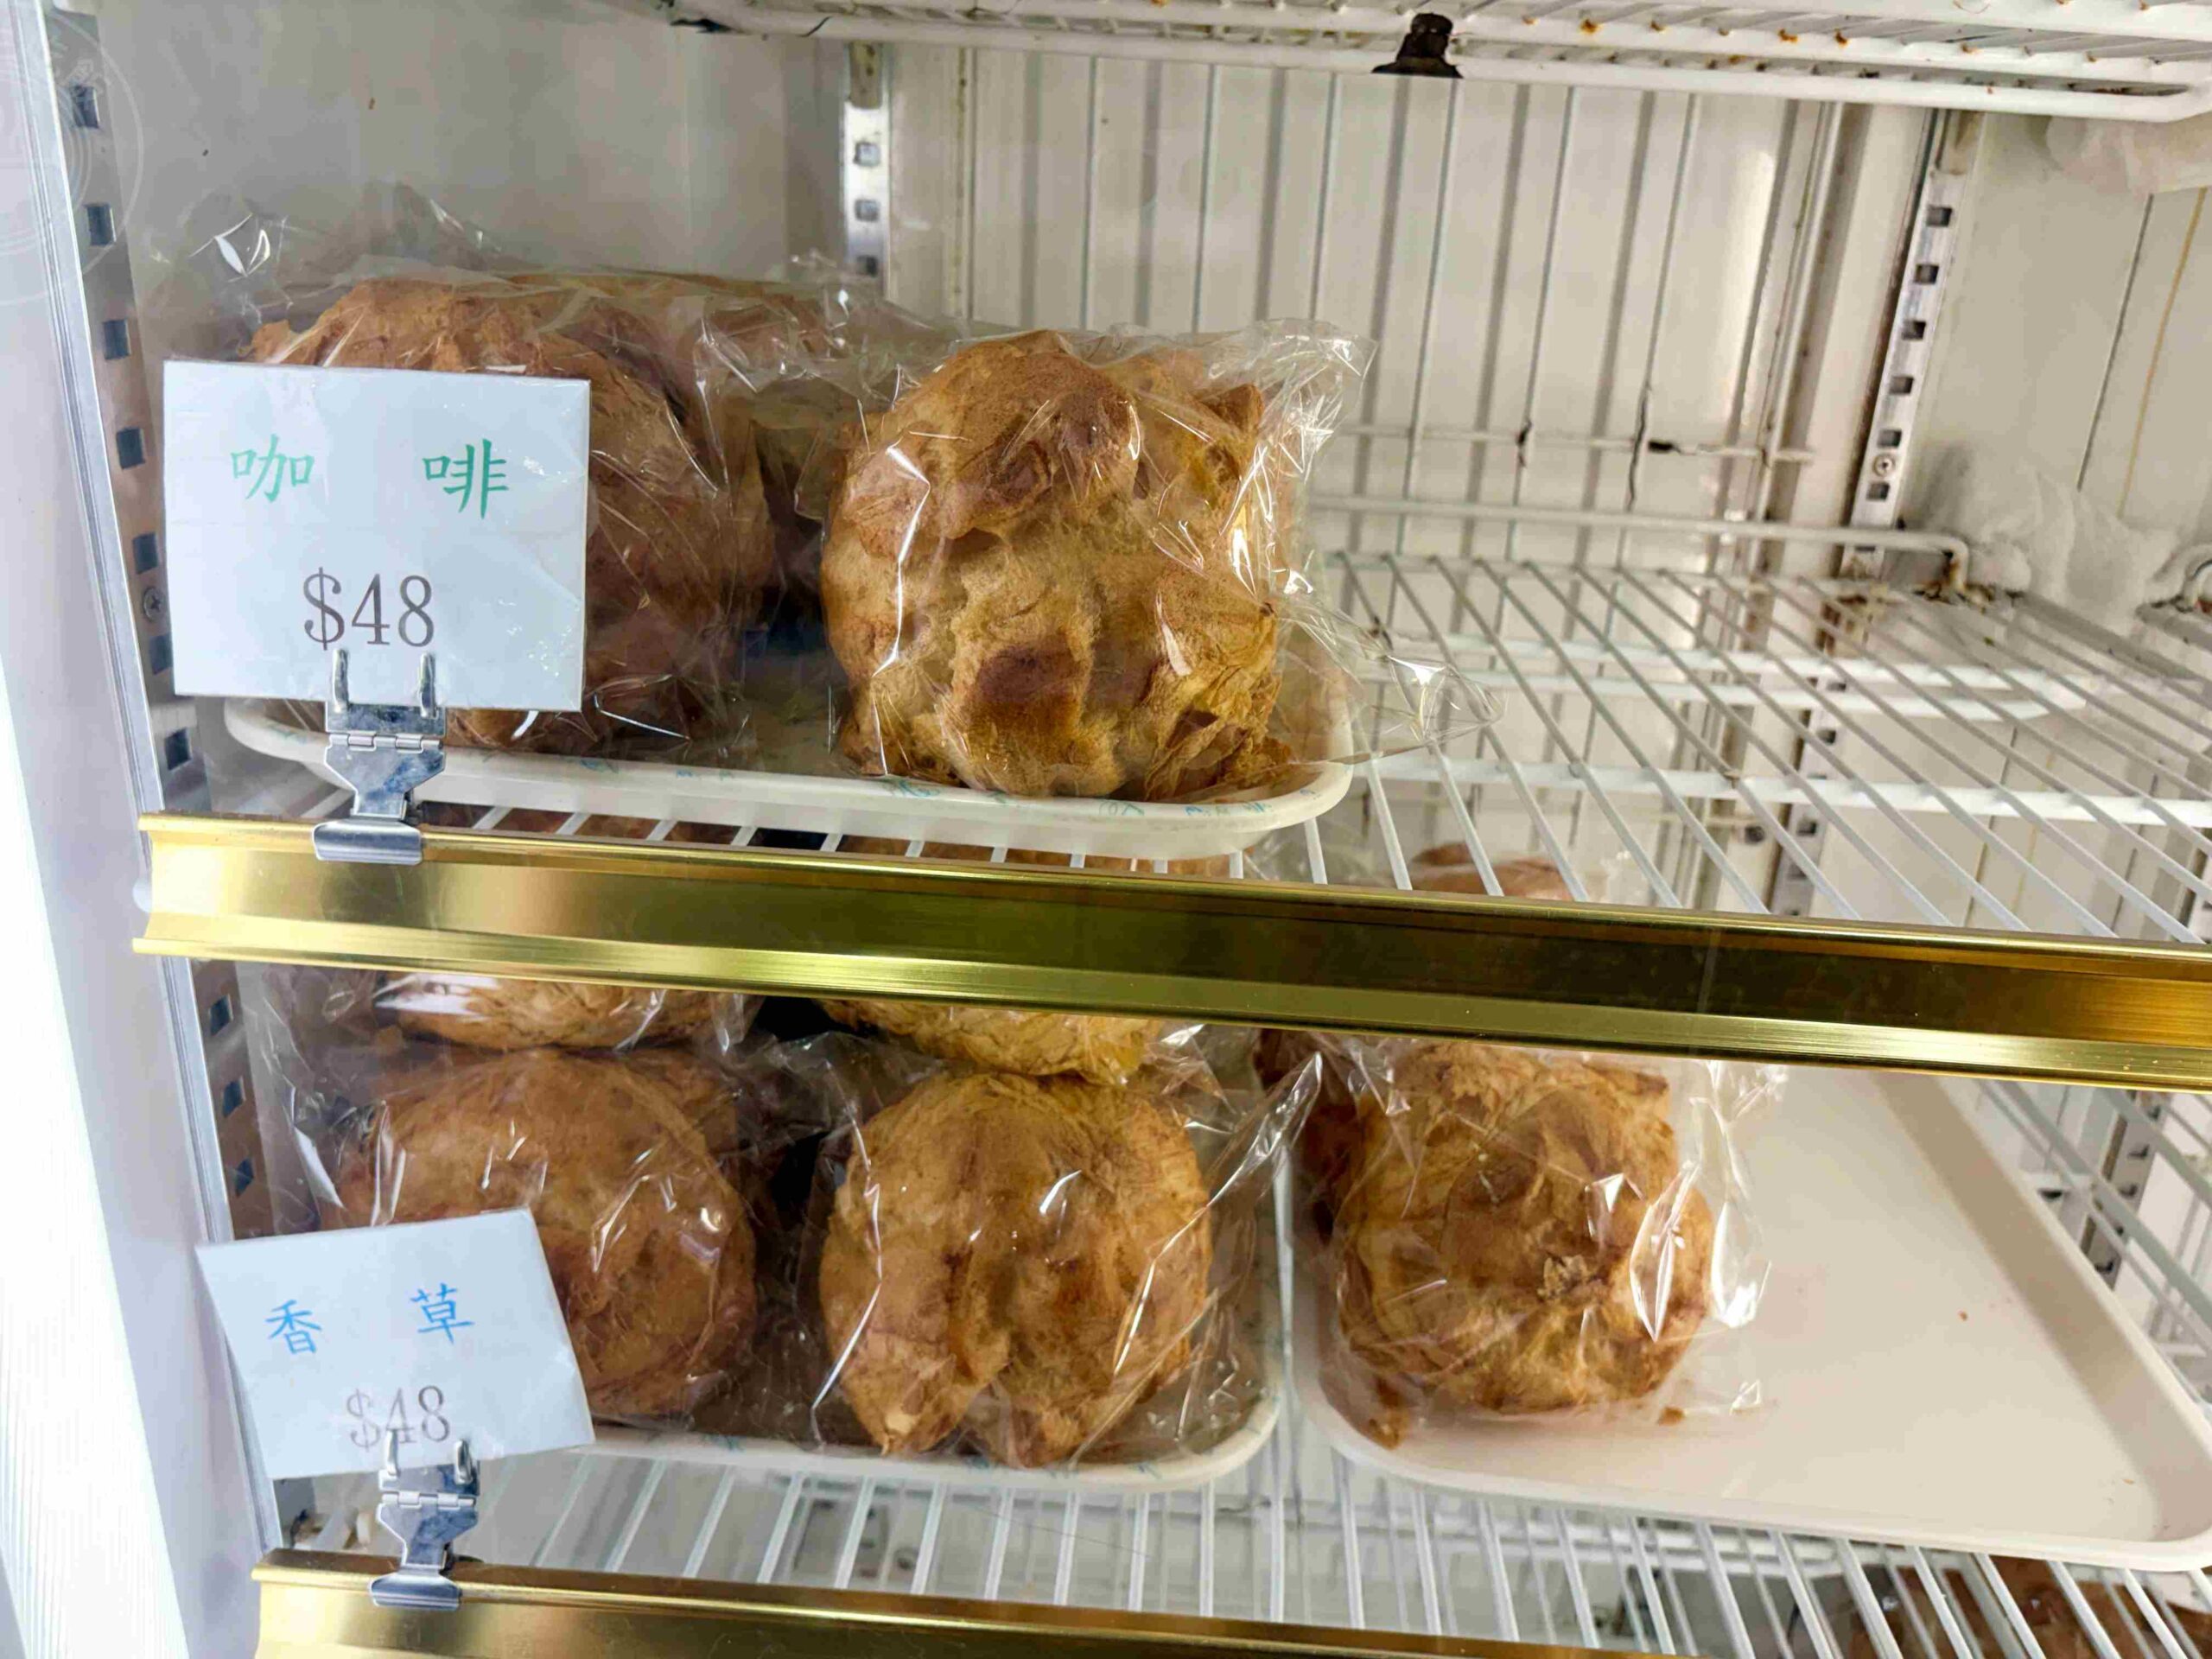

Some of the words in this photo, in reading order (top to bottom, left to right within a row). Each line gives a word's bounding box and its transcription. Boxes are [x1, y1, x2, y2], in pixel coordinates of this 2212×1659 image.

[230, 433, 509, 519] 咖啡
[302, 567, 435, 651] $48
[265, 1283, 474, 1355] 香草
[346, 1385, 451, 1452] $48
